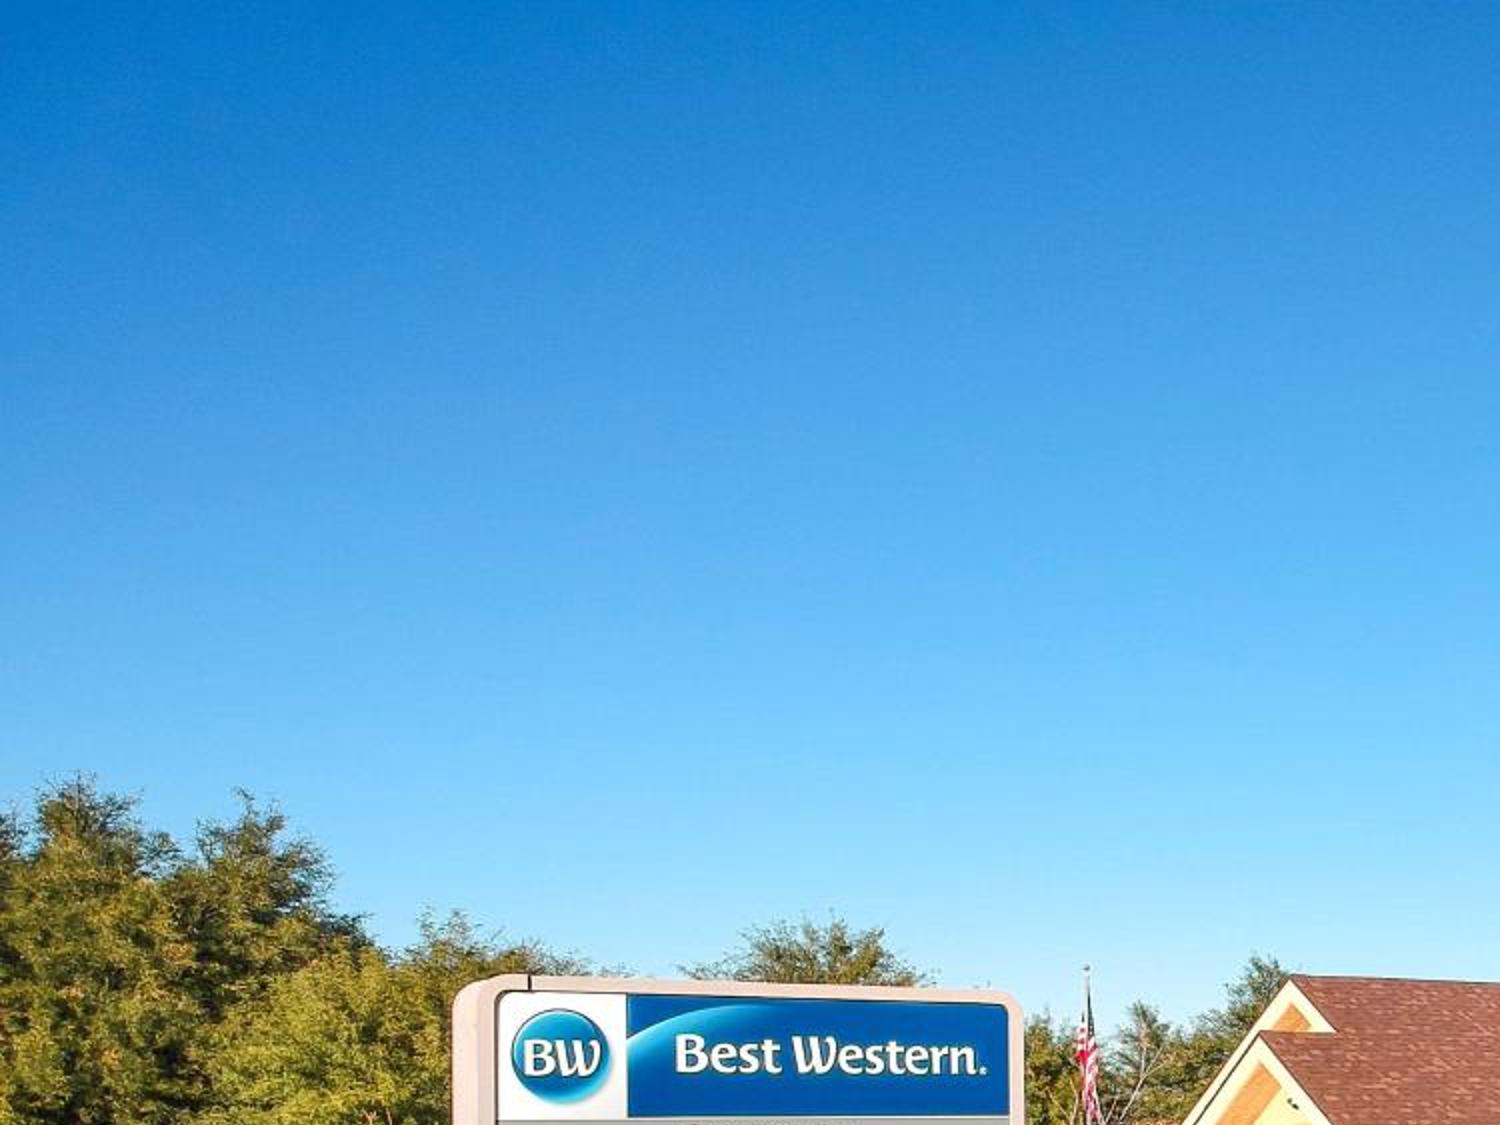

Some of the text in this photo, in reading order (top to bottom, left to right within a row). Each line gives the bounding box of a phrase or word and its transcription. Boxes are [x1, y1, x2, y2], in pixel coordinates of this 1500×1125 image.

[523, 1039, 601, 1076] BW
[674, 1034, 977, 1076] Best Western
